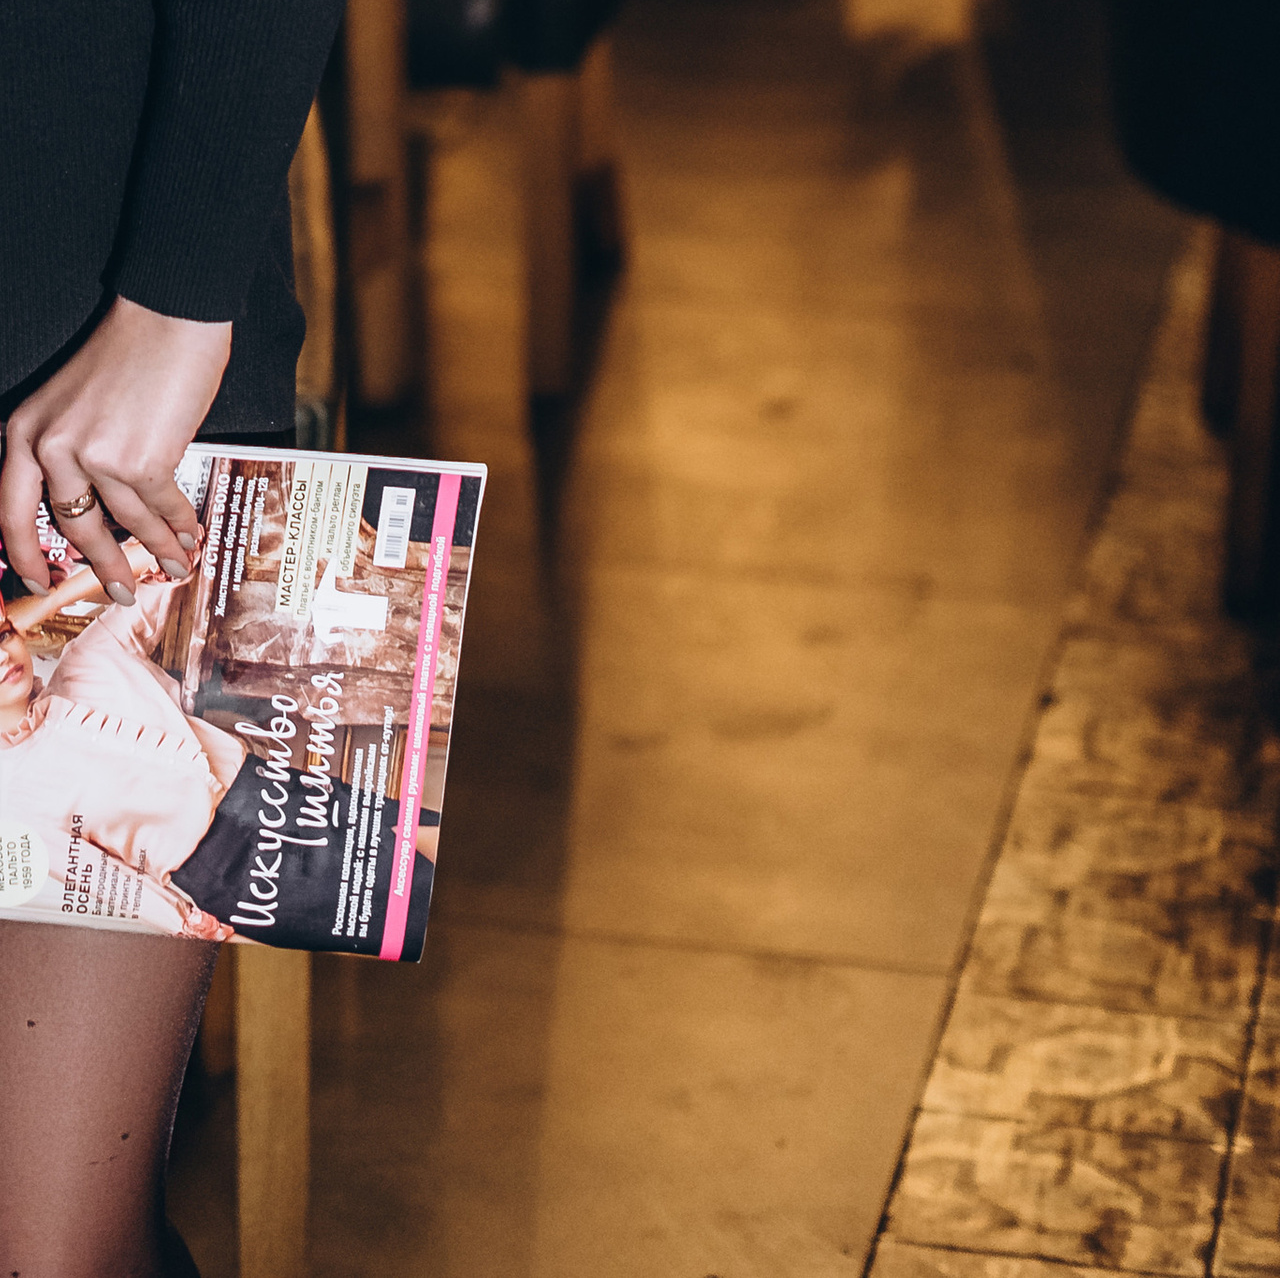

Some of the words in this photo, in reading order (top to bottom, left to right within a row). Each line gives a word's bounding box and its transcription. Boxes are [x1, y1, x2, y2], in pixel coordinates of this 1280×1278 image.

[212, 472, 231, 513] БОХО
[228, 493, 242, 513] plus
[231, 474, 244, 493] size
[241, 475, 259, 527] мальчиков,
[331, 481, 343, 512] реглан
[205, 513, 224, 564] СТИЛЕ
[222, 513, 239, 549] образы
[237, 528, 249, 546] для
[248, 513, 264, 556] размеры
[278, 478, 307, 606] МАСТЕР-КЛАССЫ
[302, 479, 324, 572] воротником-бантом
[326, 513, 338, 546] пальто
[339, 519, 356, 571] объемного
[348, 482, 362, 519] силуэта
[202, 565, 217, 579] В
[213, 549, 233, 617] Женственные
[233, 546, 247, 583] модели
[428, 535, 448, 591] подгибкой
[232, 583, 241, 591] и
[296, 581, 310, 616] Платье
[421, 592, 441, 642] изящной
[423, 643, 433, 651] с
[417, 653, 432, 690] платок
[377, 704, 397, 754] от-кутюр!
[409, 691, 428, 748] шелковый
[295, 671, 345, 829] шитья
[346, 747, 366, 824] вдохновленная
[359, 742, 380, 807] выкройками
[373, 754, 391, 809] традициях
[406, 750, 424, 795] руками:
[230, 694, 328, 926] Искусство
[356, 807, 371, 849] нашими
[369, 809, 385, 848] лучших
[402, 796, 417, 838] своими
[6, 841, 18, 885] ПАЛЬТО
[19, 832, 30, 863] ГОДА
[61, 813, 84, 913] ЭЛЕГАНТНАЯ
[136, 848, 147, 876] тонах
[339, 824, 357, 881] коллекция,
[355, 849, 365, 857] с
[368, 847, 378, 856] в
[392, 839, 412, 897] Аксессуар
[21, 865, 32, 889] 1959
[75, 862, 93, 914] ОСЕНЬ
[91, 850, 109, 915] Благородные
[106, 863, 120, 917] материалы
[120, 874, 131, 910] принты
[349, 857, 365, 894] модой:
[364, 856, 378, 888] одеты
[330, 880, 349, 936] Роскошная
[343, 894, 359, 937] высокой
[357, 888, 375, 923] будете
[358, 923, 368, 937] вы
